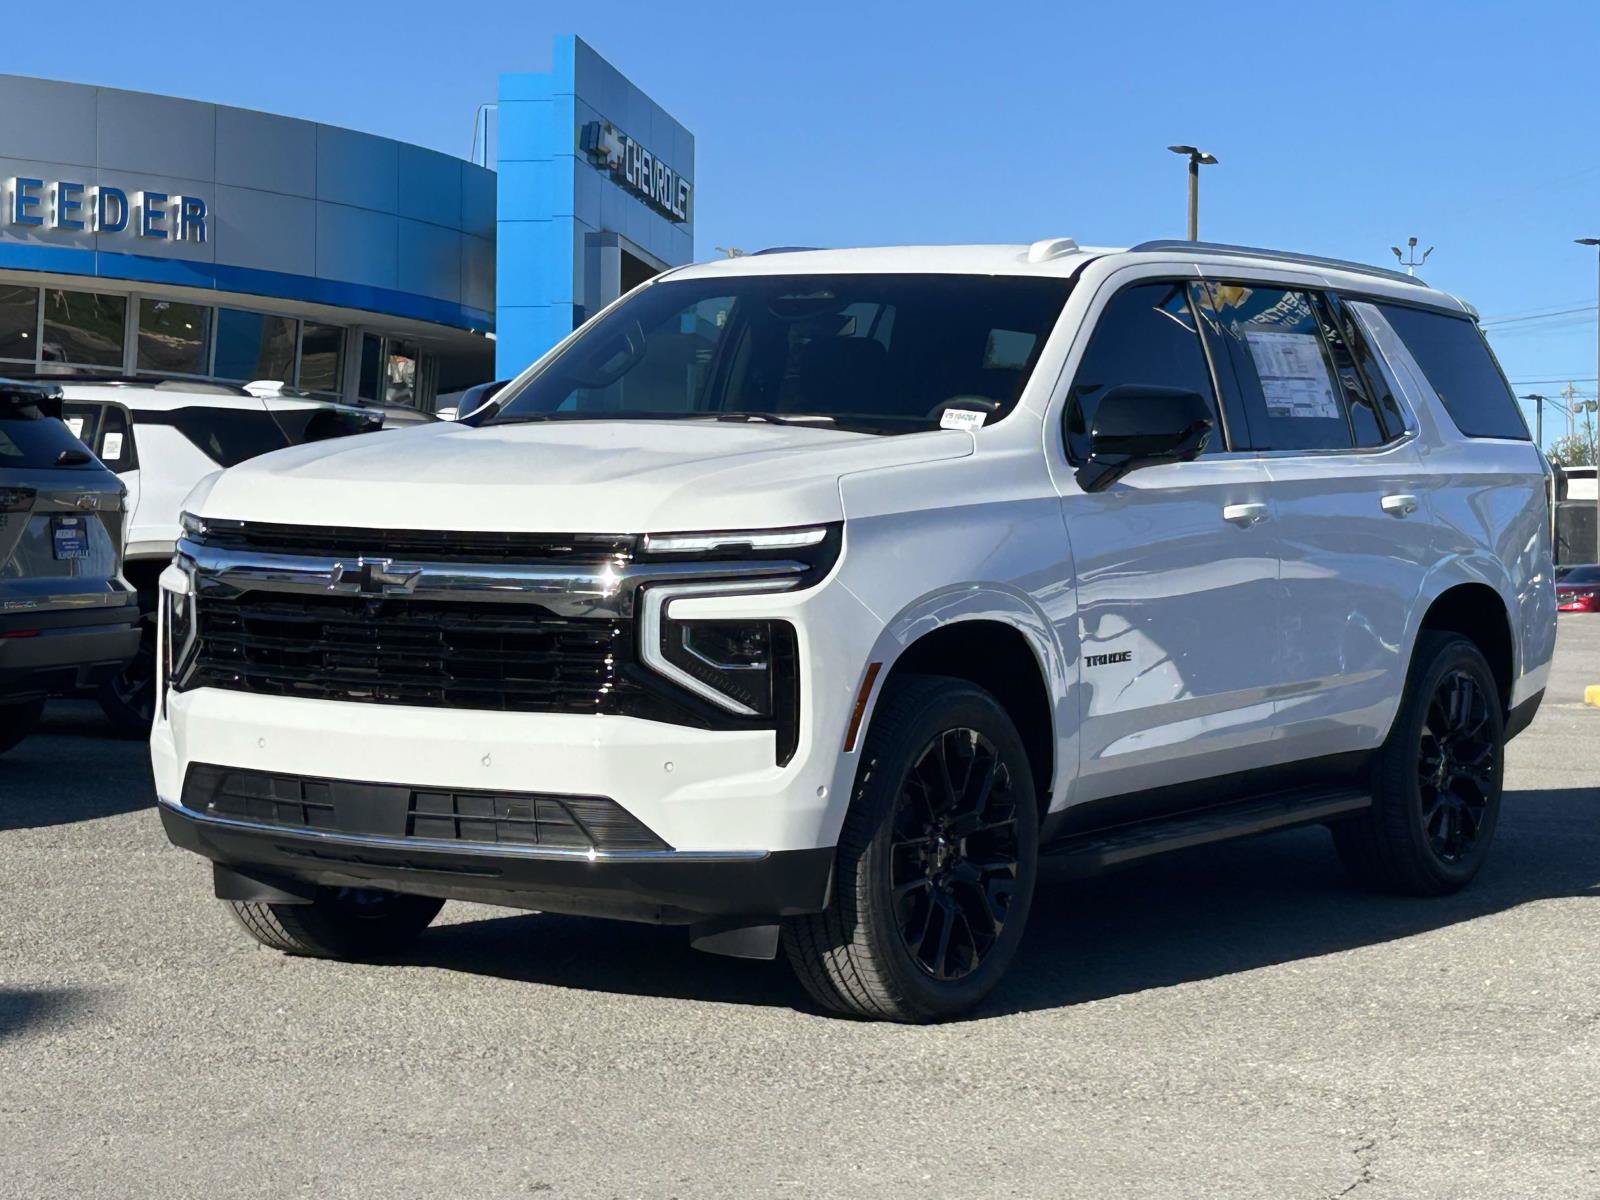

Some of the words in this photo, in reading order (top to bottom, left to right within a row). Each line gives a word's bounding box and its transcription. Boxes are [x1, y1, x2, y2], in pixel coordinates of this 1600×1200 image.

[13, 177, 207, 242] EEDER
[626, 136, 691, 220] CHEVROLET
[1084, 650, 1132, 667] TAHOE
